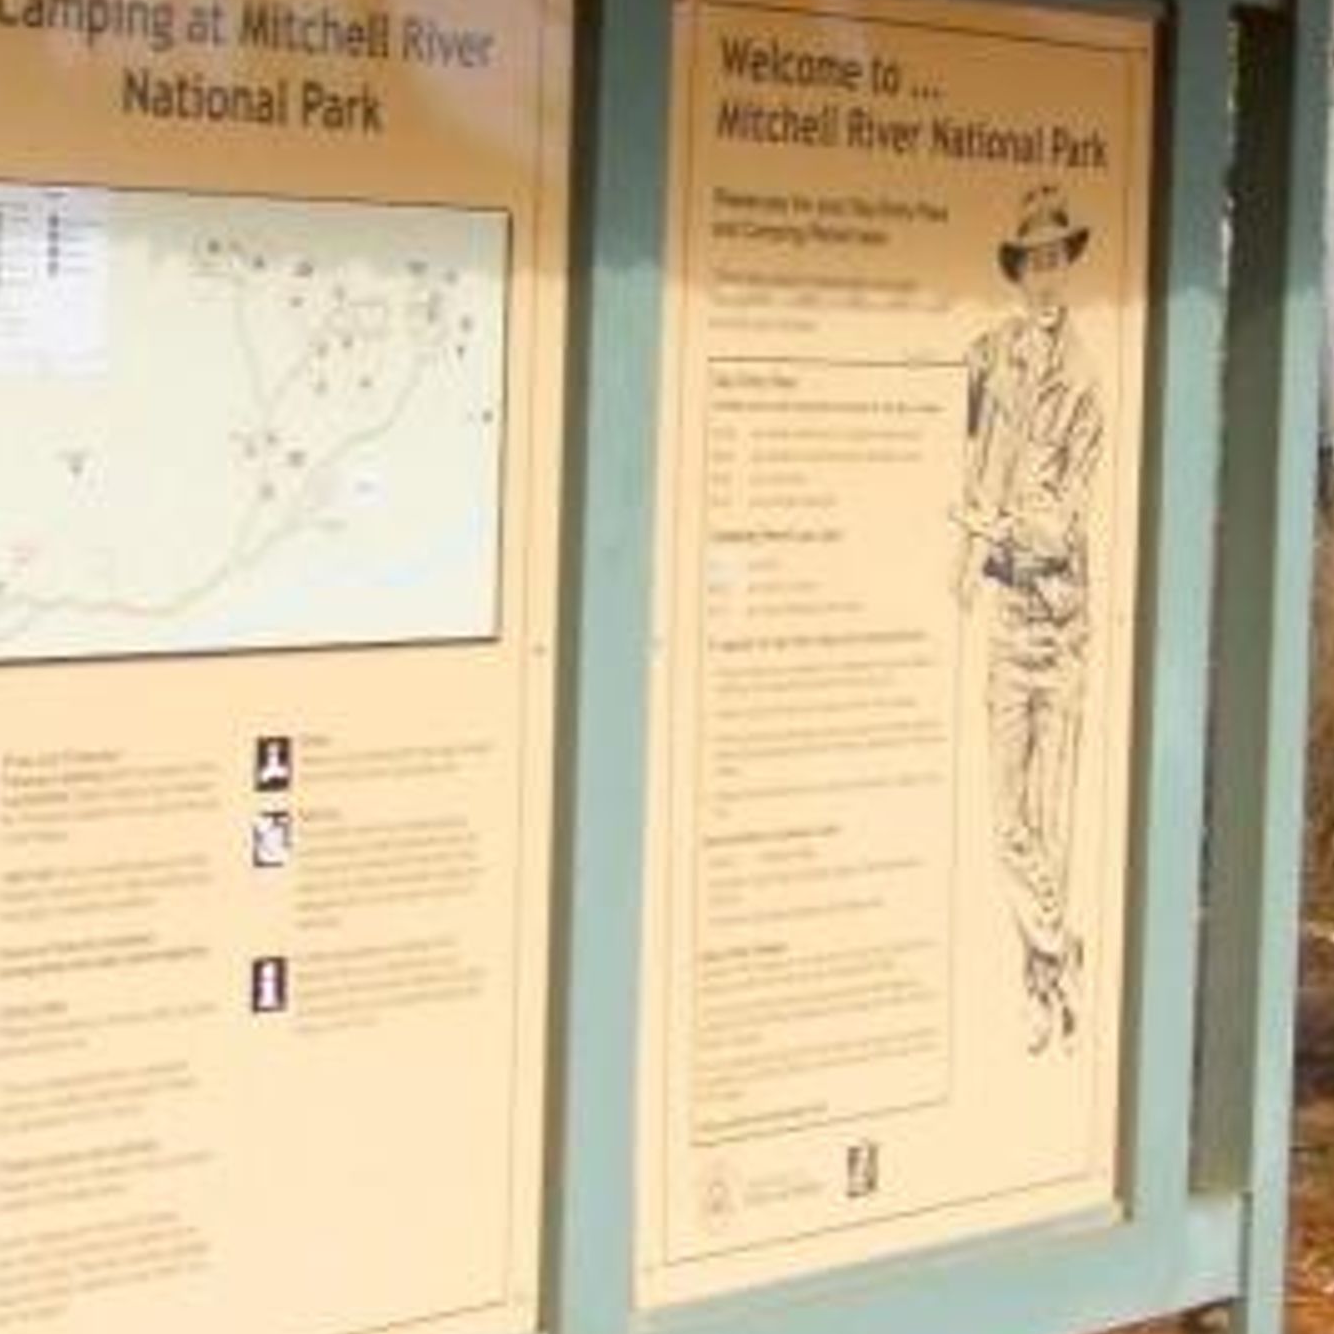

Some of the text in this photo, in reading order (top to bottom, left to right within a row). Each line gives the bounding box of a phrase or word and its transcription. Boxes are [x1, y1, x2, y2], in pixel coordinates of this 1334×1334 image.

[238, 0, 390, 58] Mitchell
[402, 13, 495, 68] River
[720, 37, 863, 93] Welcome
[872, 57, 901, 97] to
[122, 67, 385, 134] National Park
[717, 100, 1109, 168] Mitchell River National Park
